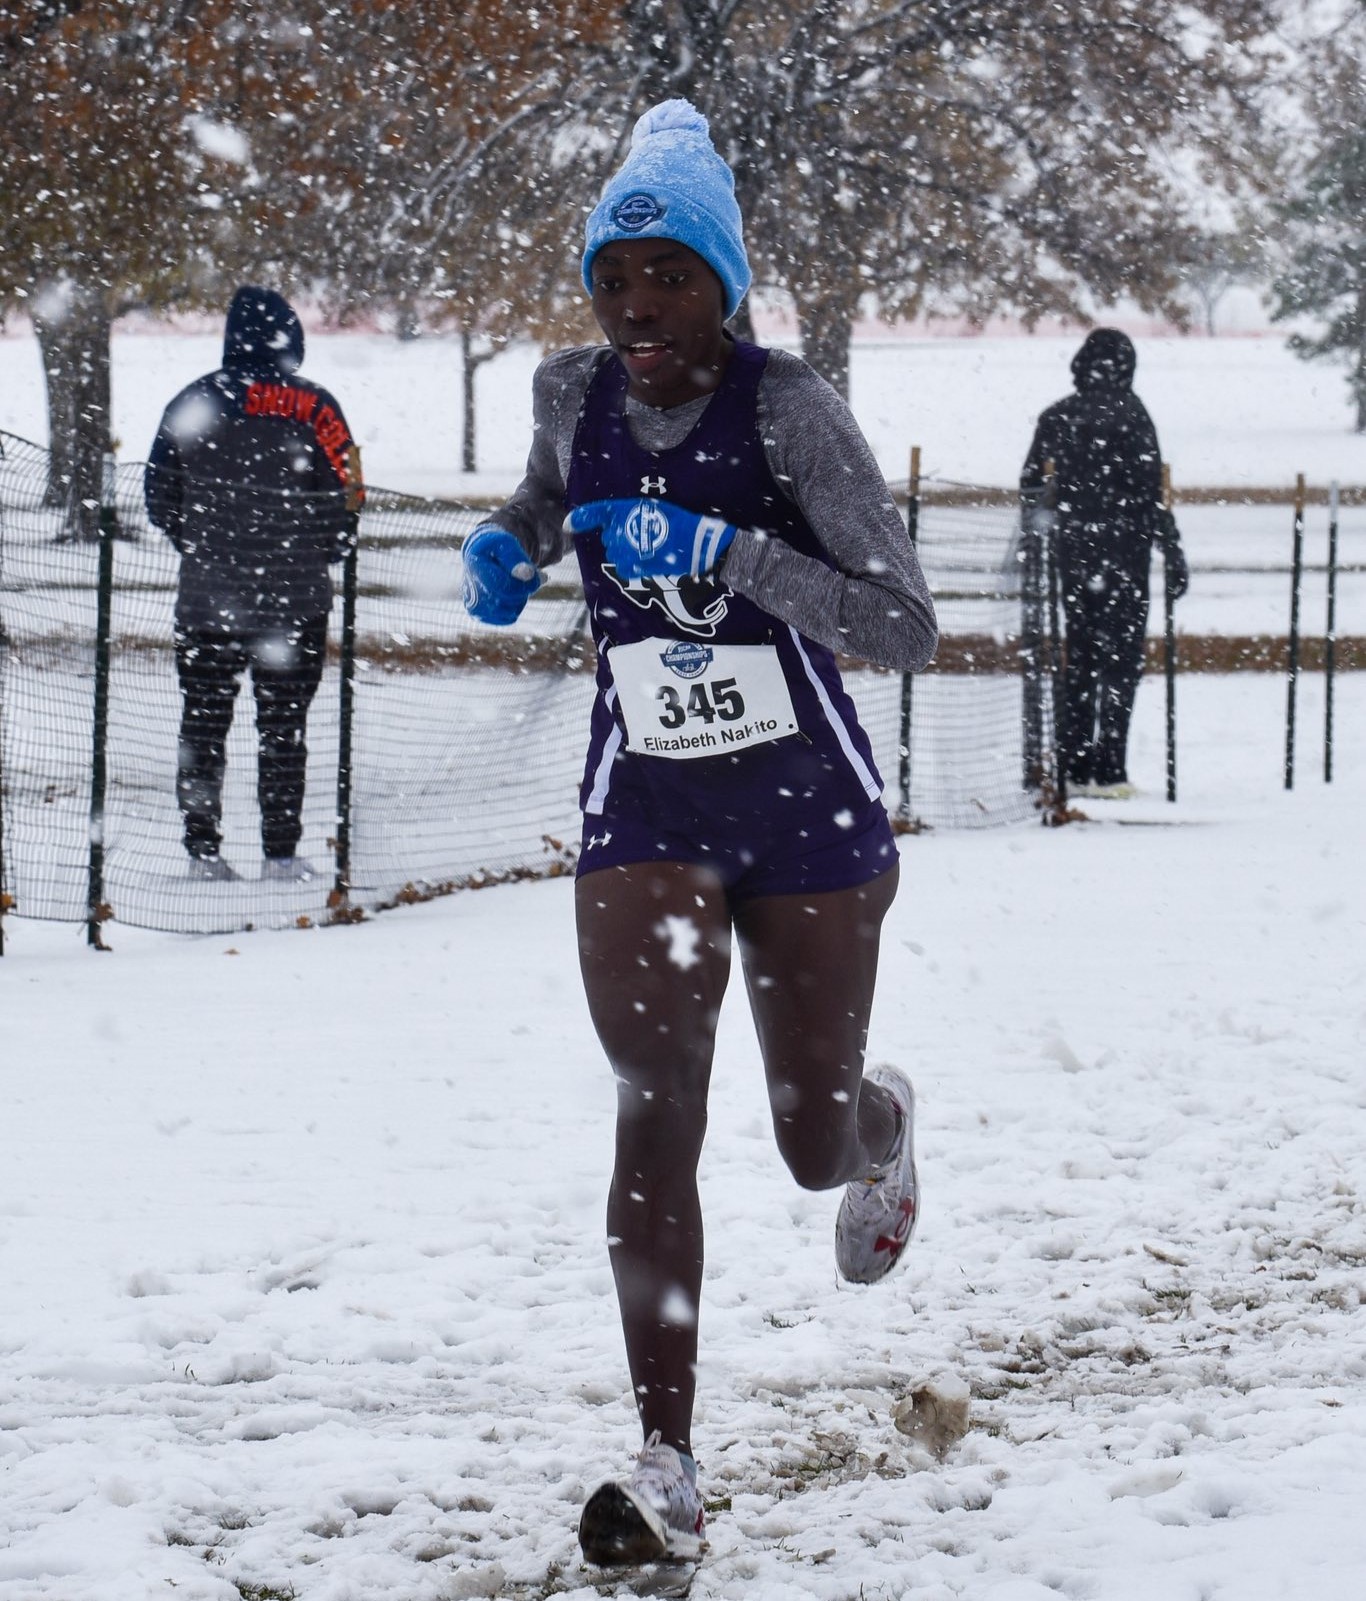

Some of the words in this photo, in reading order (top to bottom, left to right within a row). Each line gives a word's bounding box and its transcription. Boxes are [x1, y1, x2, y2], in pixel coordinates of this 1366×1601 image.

[245, 382, 318, 421] SNOW
[655, 677, 745, 729] 345
[644, 731, 716, 752] Elizabeth
[721, 719, 777, 743] Nakito
